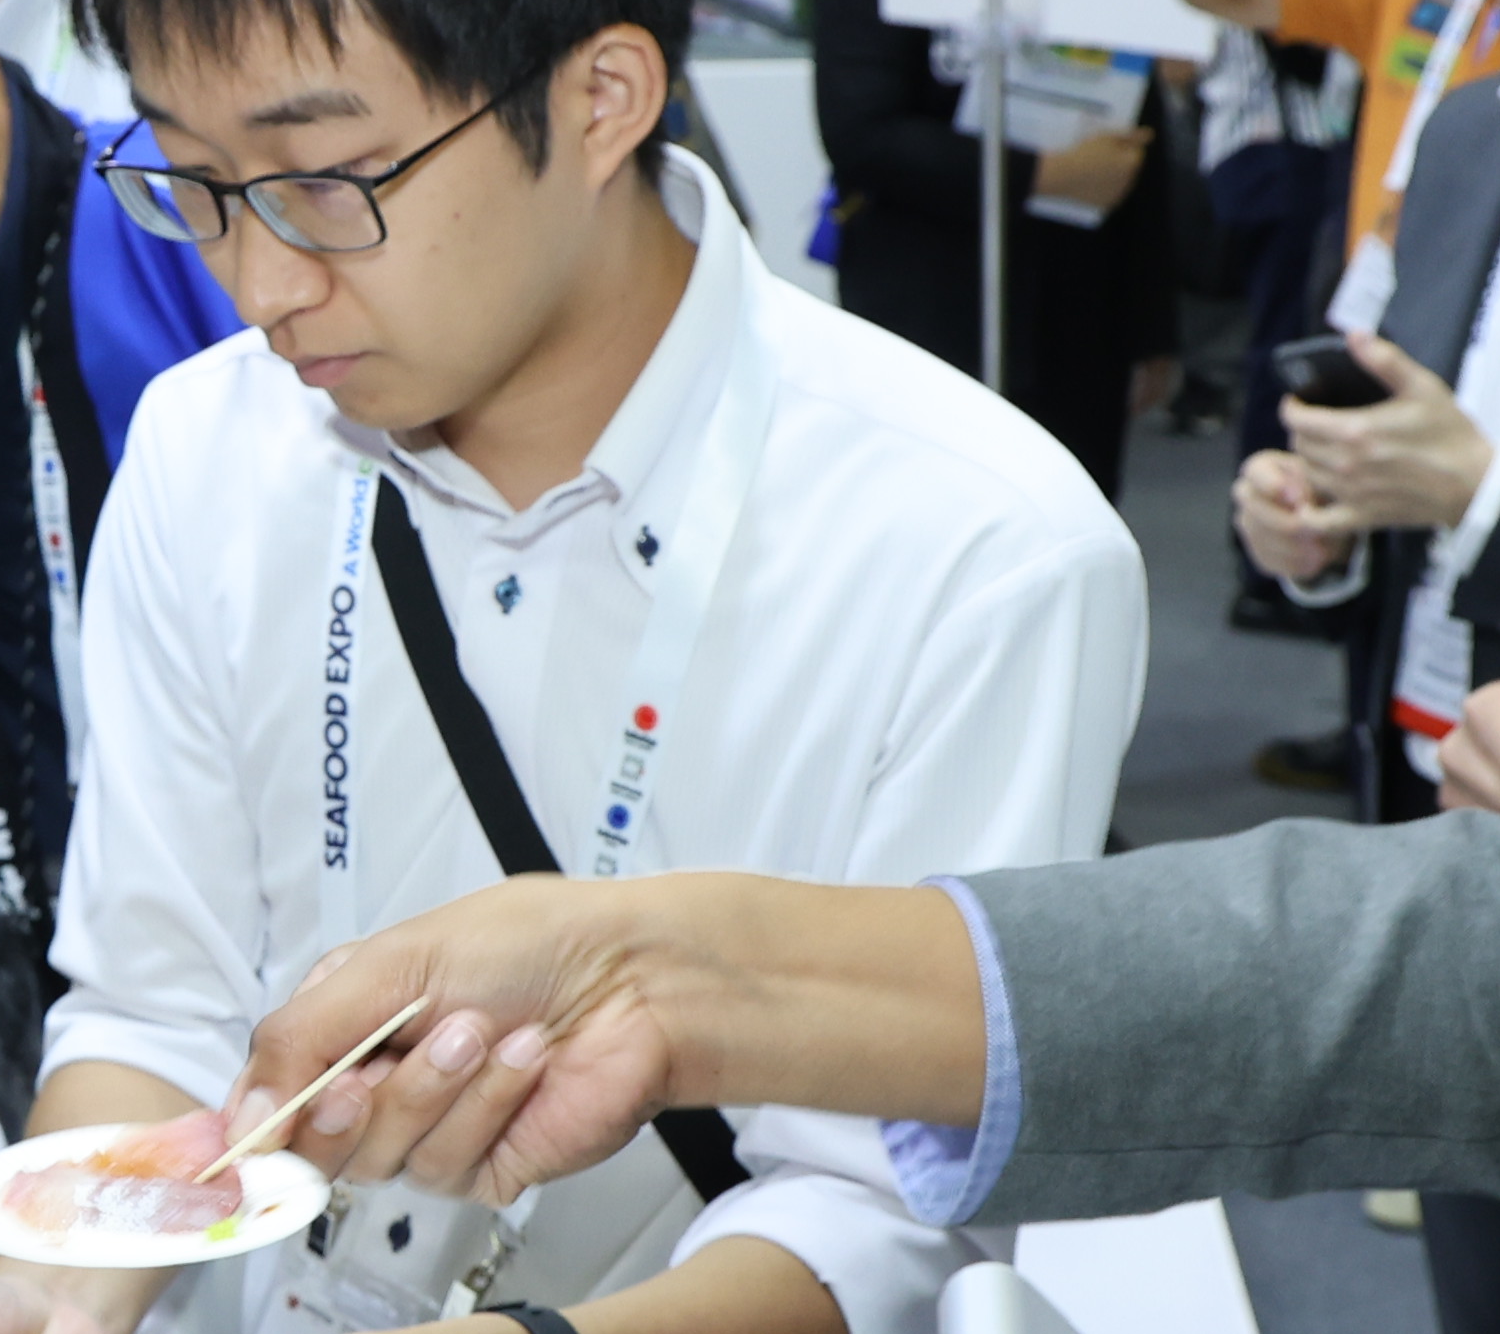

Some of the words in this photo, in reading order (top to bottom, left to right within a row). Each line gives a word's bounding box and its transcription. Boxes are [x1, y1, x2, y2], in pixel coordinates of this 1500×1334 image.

[346, 478, 369, 555] World
[343, 559, 358, 578] A
[326, 585, 355, 684] EXPO
[324, 693, 349, 869] SEAFOOD
